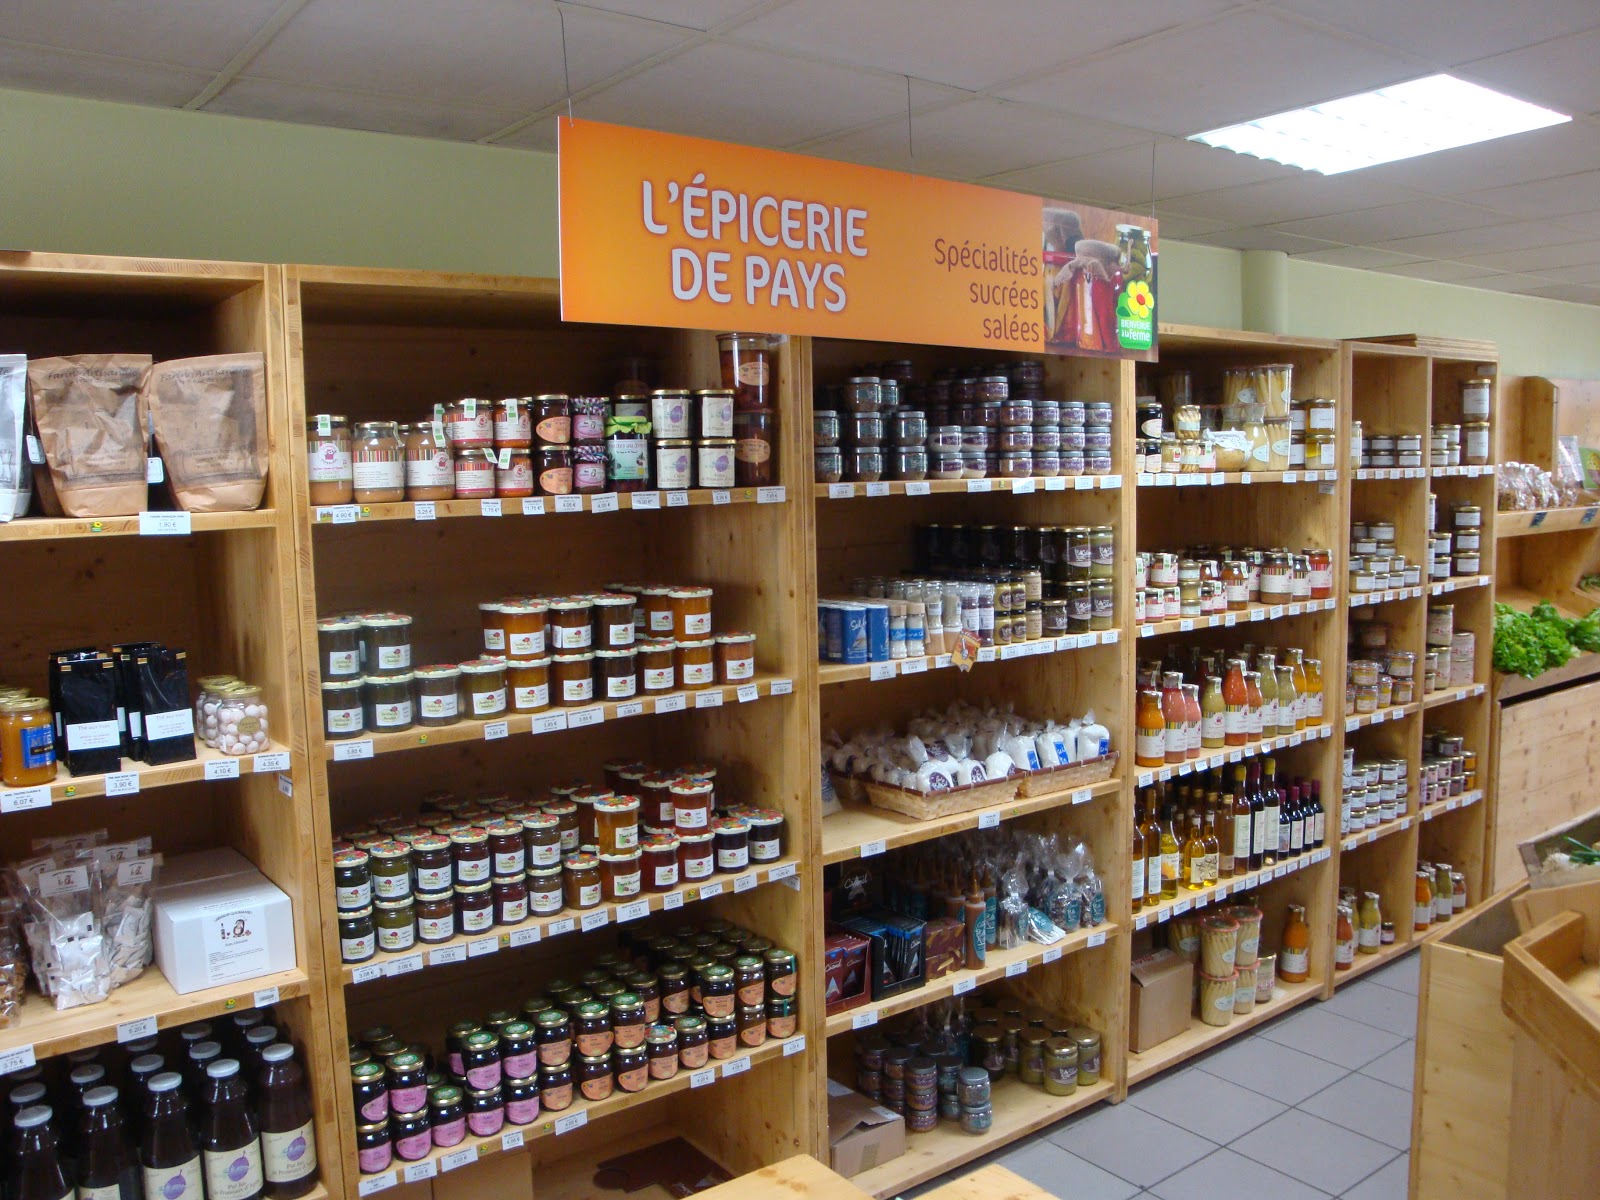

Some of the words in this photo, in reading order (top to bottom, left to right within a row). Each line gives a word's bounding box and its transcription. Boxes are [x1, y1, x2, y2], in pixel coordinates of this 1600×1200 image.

[642, 173, 868, 257] L'ÉPICERIE
[934, 238, 1039, 277] Spécialités
[671, 248, 732, 302] DE
[746, 253, 847, 313] PAYS
[970, 279, 1040, 309] sucrées
[983, 312, 1040, 343] salées
[1120, 319, 1151, 331] BIENVENUE
